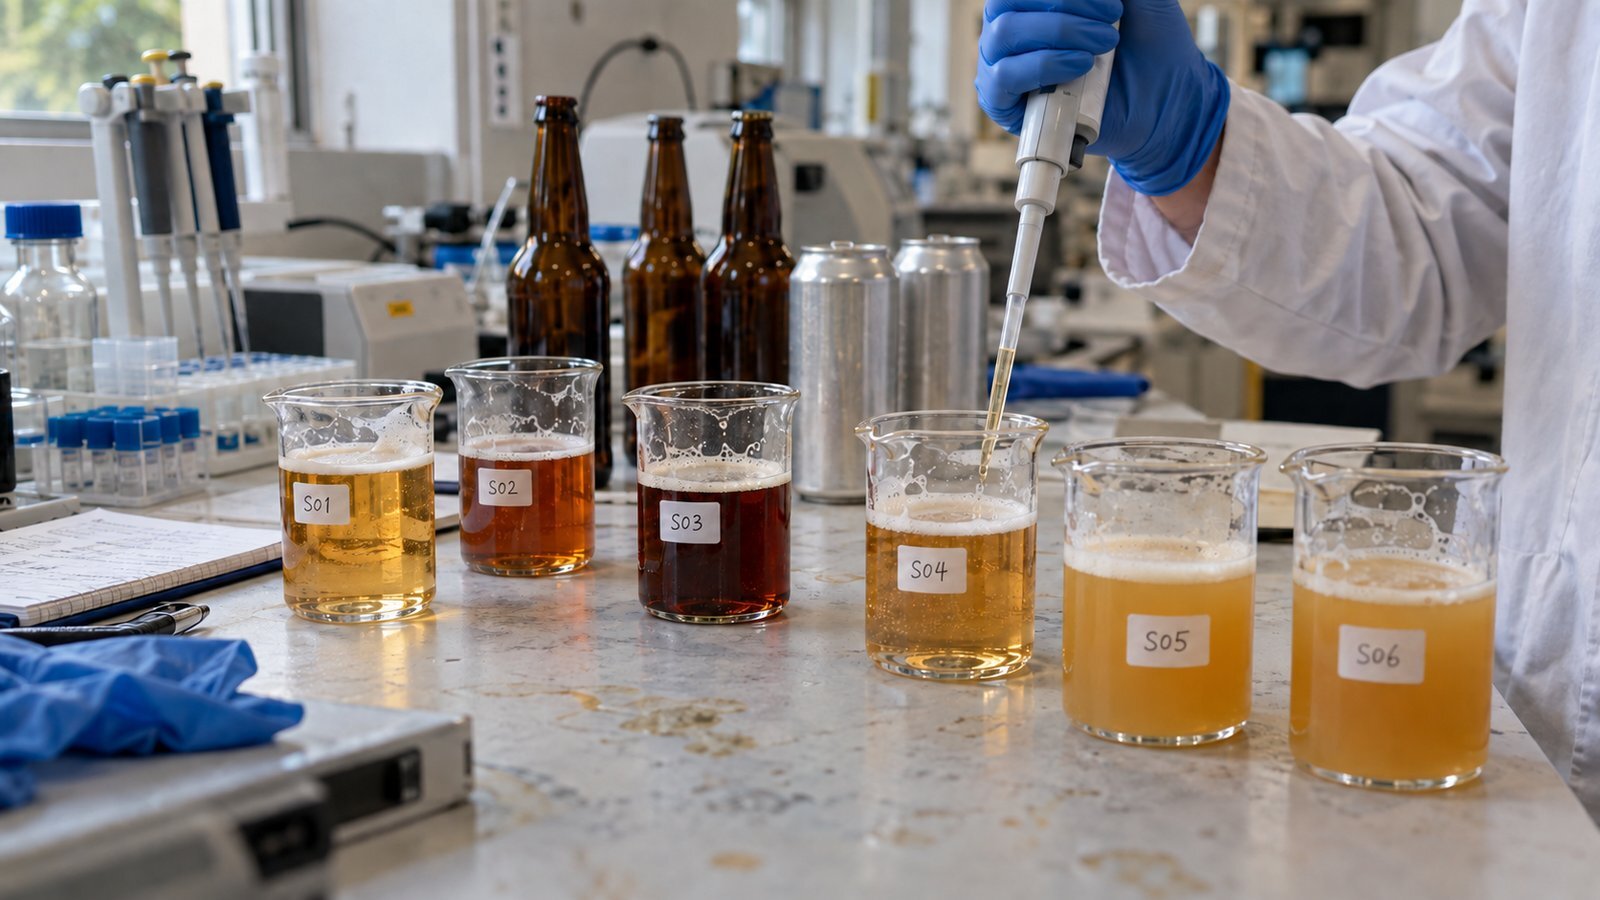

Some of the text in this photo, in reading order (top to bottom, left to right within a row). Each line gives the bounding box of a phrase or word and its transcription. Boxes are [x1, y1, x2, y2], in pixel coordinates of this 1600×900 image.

[488, 479, 519, 495] S02
[303, 494, 330, 514] S01
[670, 513, 703, 532] S03
[910, 559, 948, 582] S04
[1144, 630, 1190, 652] S05
[1356, 644, 1402, 668] S06
